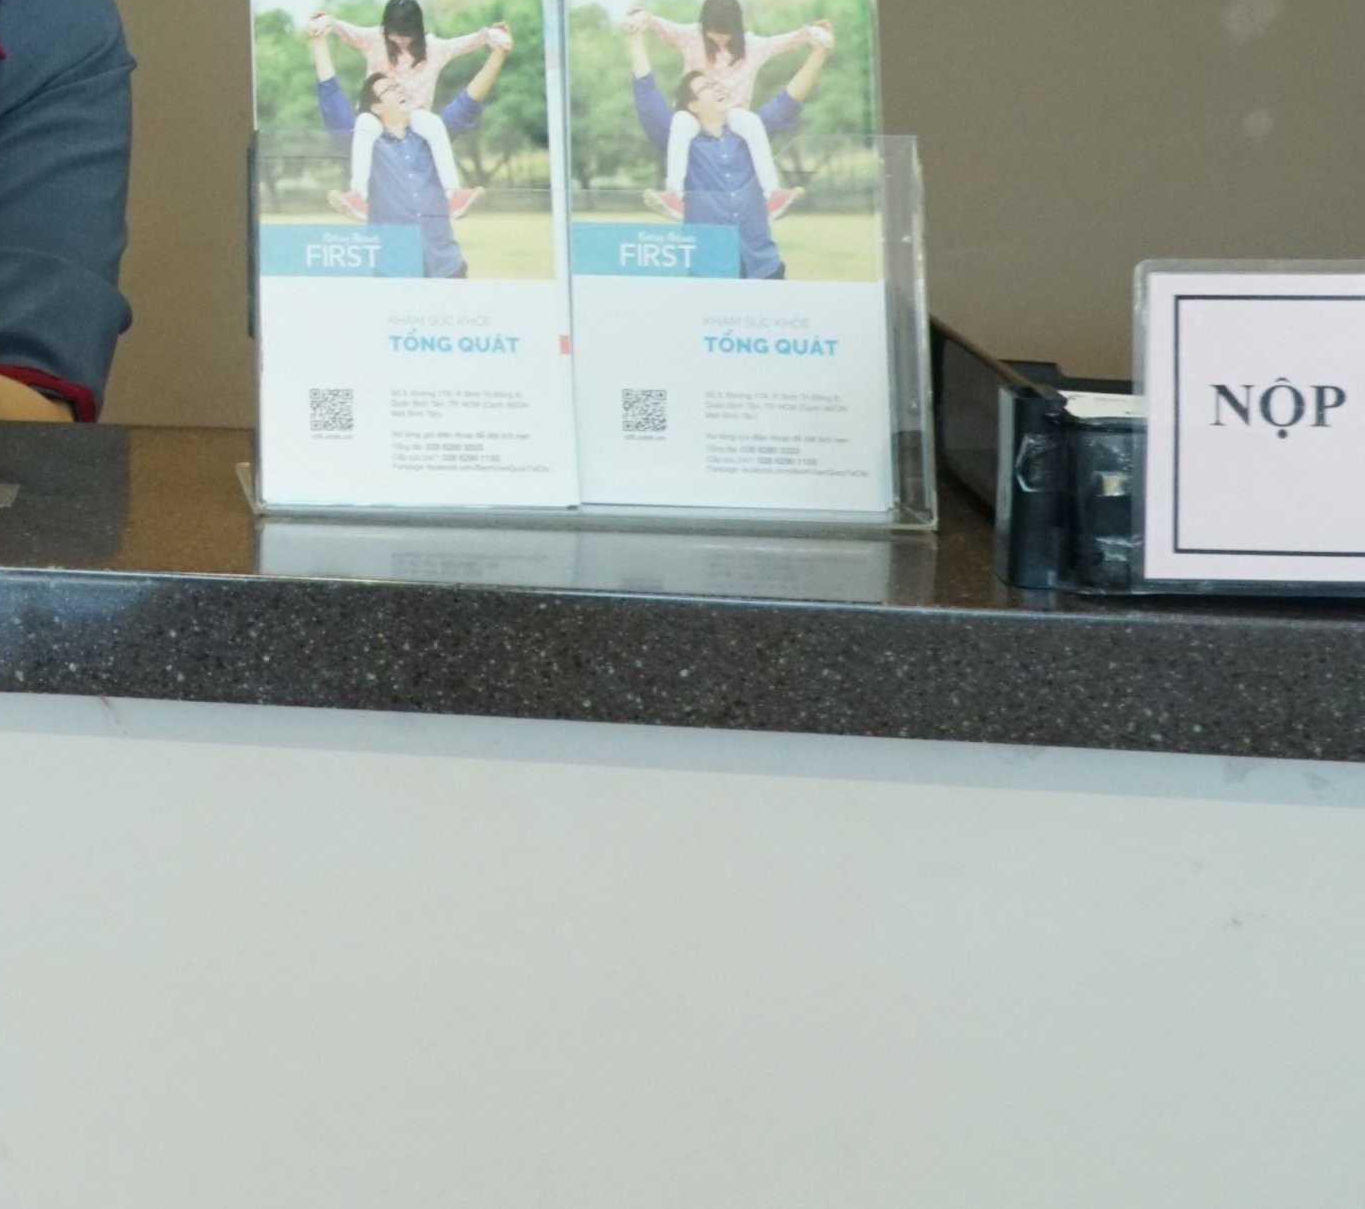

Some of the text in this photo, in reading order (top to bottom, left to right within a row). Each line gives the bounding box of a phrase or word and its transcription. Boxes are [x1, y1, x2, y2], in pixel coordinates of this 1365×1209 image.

[305, 243, 381, 269] FIRST
[619, 243, 697, 269] FIRST
[388, 326, 521, 354] TỔNG QUÁT
[703, 328, 839, 356] TỔNG QUÁT
[1209, 376, 1347, 440] NỘP
